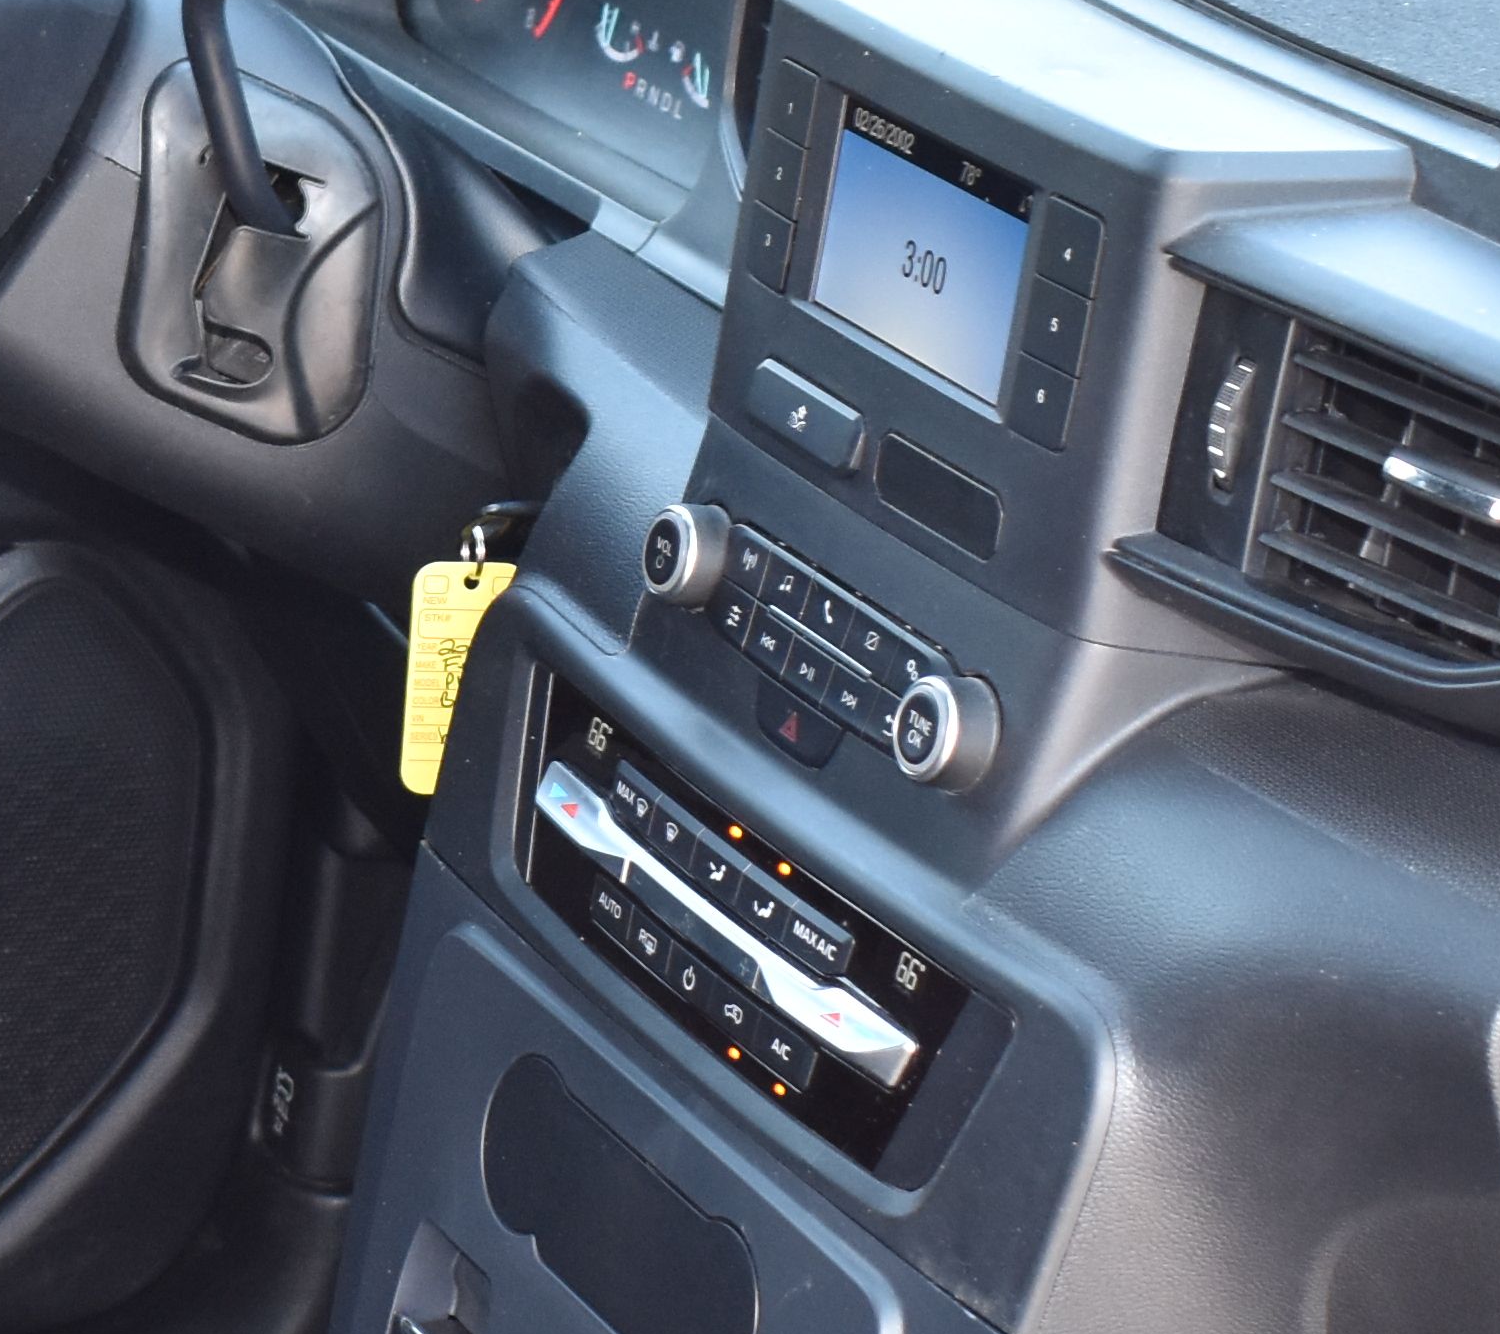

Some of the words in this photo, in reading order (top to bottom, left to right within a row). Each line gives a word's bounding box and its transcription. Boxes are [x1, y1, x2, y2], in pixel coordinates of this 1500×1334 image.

[787, 102, 793, 115] 1
[775, 167, 783, 181] 2
[764, 233, 772, 247] 3
[1064, 247, 1072, 262] 4
[902, 240, 948, 295] 3:00
[1050, 317, 1059, 332] 5
[1037, 388, 1045, 404] 6
[657, 535, 672, 558] VOL
[423, 596, 448, 605] NEW
[424, 613, 452, 622] STK#
[417, 643, 438, 651] YEAR
[415, 660, 437, 669] MAKE
[413, 678, 441, 687] MODEL
[411, 715, 425, 723] VIN
[909, 709, 933, 735] TUNE
[907, 729, 923, 749] OK
[616, 780, 636, 805] MAX
[598, 892, 623, 920] AUTO
[793, 919, 819, 949] MAX
[816, 937, 837, 962] A/C
[771, 1036, 792, 1061] A/C
